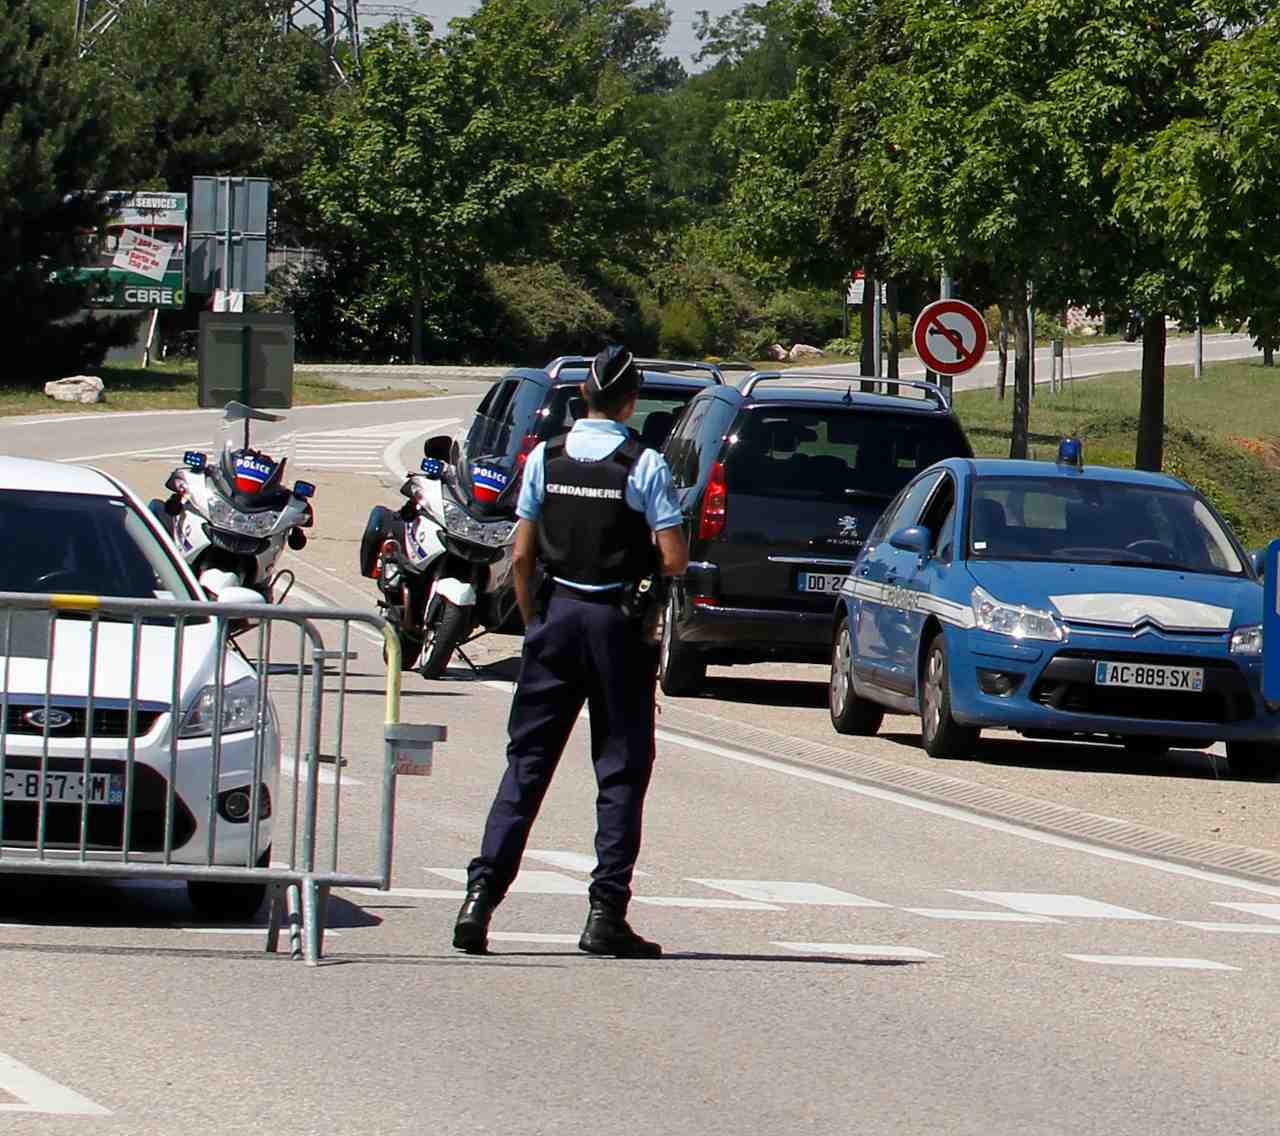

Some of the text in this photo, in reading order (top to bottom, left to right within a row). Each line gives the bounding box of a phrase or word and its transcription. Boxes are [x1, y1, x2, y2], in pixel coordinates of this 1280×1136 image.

[135, 197, 177, 209] SERVICES
[124, 289, 173, 304] CBRE
[236, 458, 271, 474] POLICE
[472, 466, 508, 485] POLICE
[546, 483, 623, 500] GENDARMERIE
[1109, 665, 1190, 688] AC-889-SX
